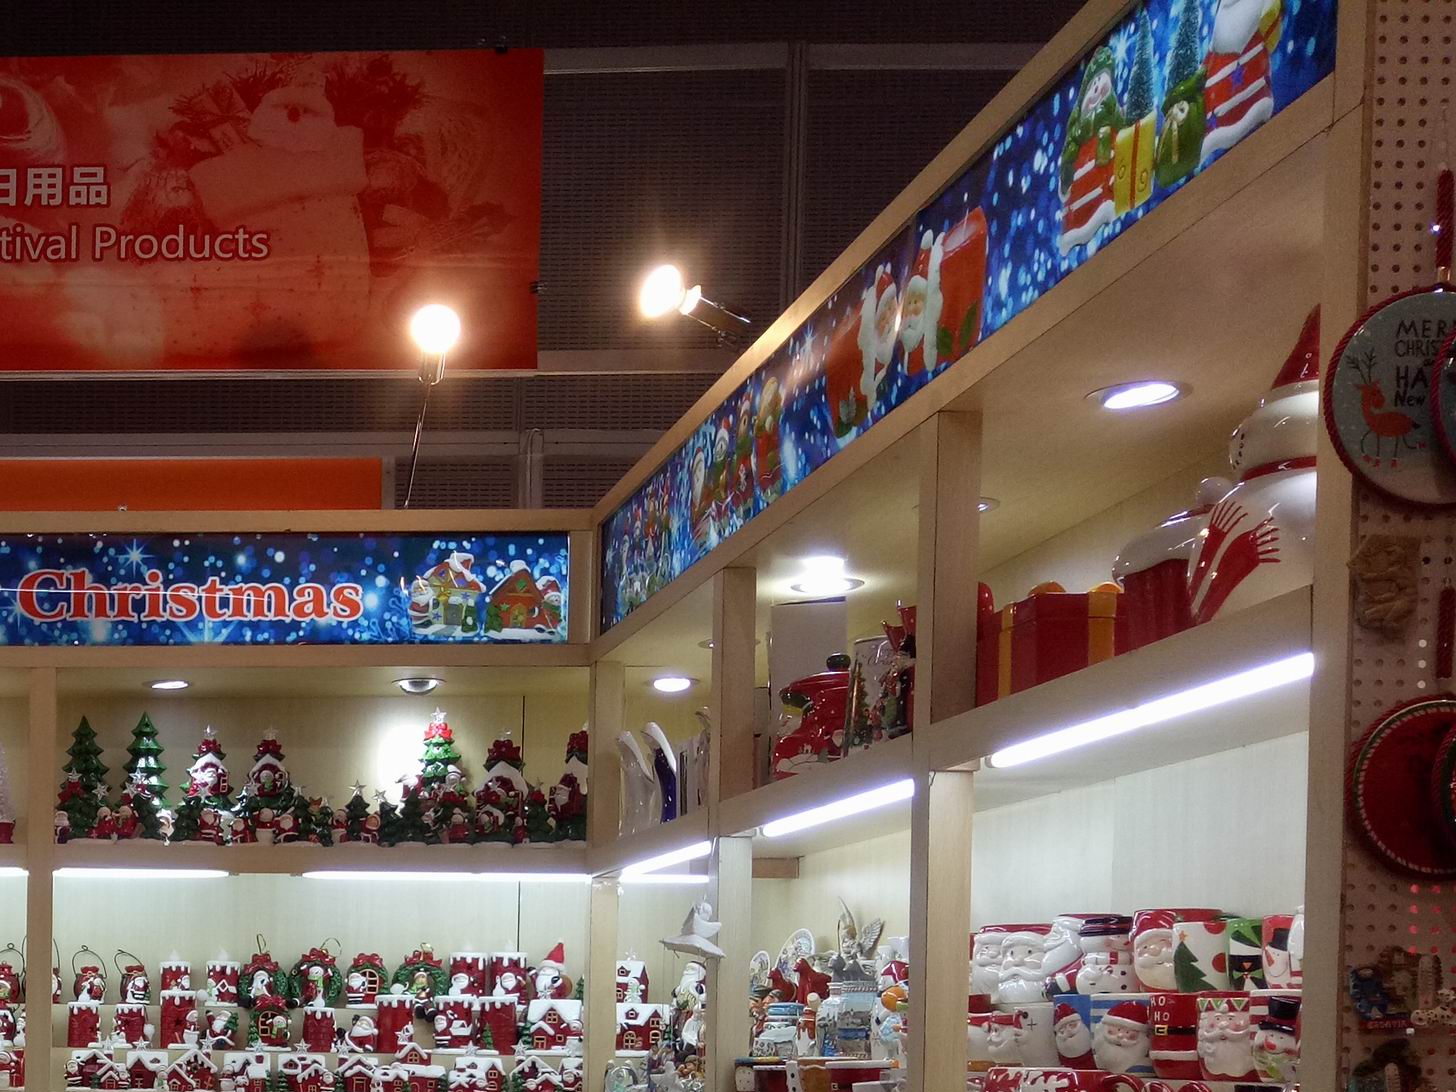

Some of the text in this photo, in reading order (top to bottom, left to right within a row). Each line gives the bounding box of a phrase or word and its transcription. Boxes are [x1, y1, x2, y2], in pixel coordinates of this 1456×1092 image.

[95, 224, 269, 260] Products
[1396, 319, 1448, 338] MER
[17, 568, 365, 622] Christmas
[1154, 1011, 1170, 1022] HO
